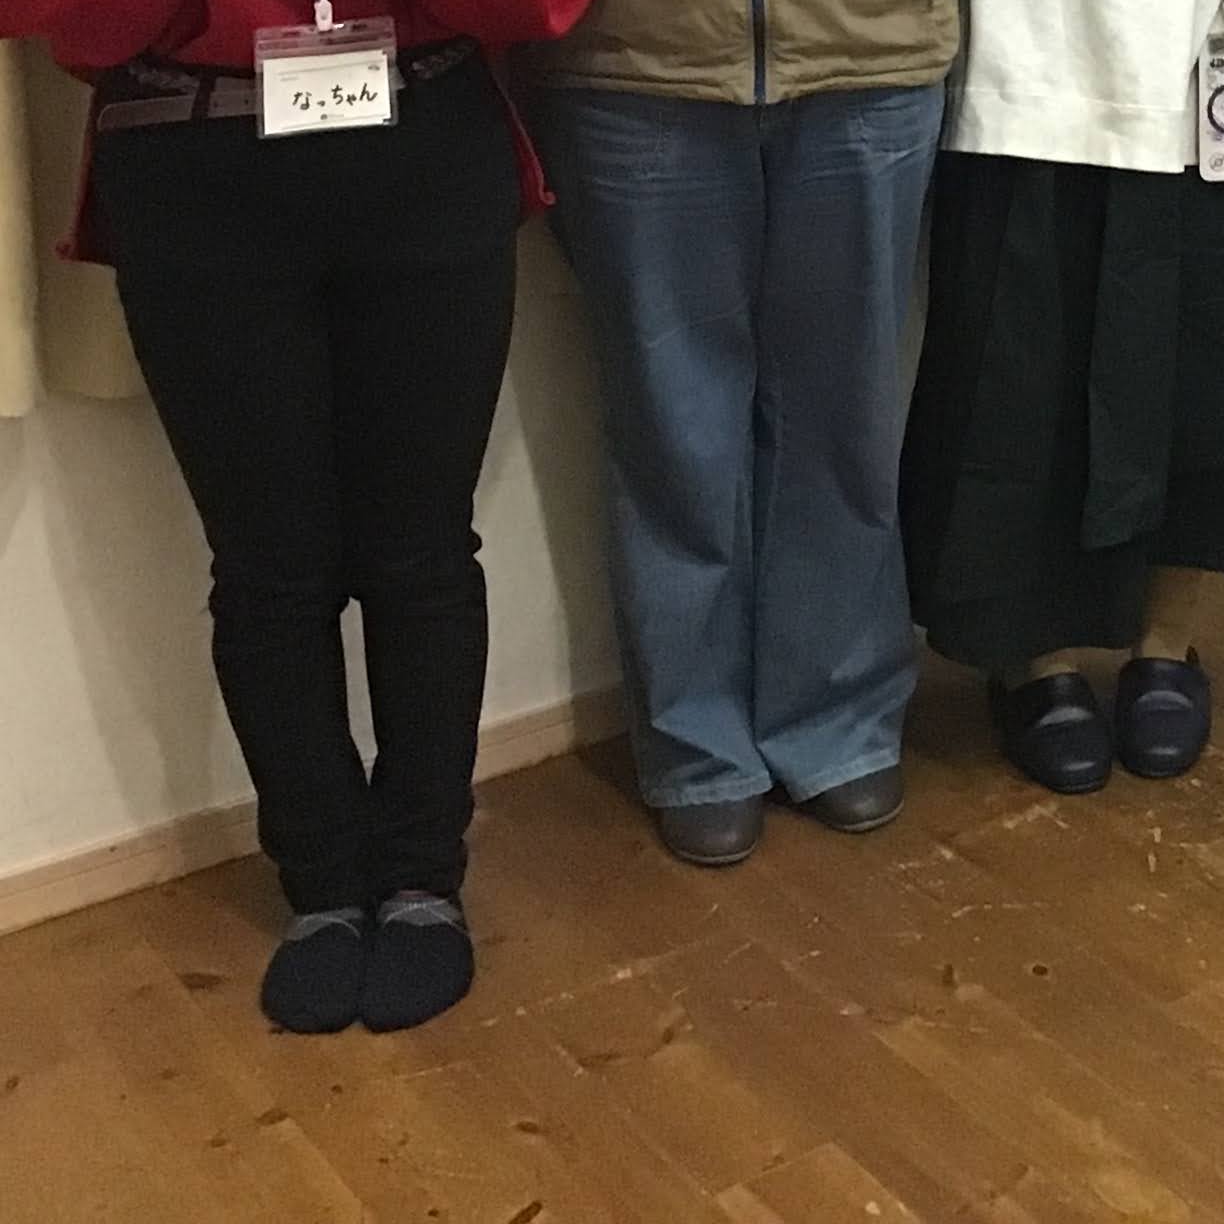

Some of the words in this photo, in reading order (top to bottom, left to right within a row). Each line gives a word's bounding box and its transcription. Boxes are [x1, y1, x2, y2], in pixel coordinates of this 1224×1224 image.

[292, 82, 379, 111] なっちゃん
